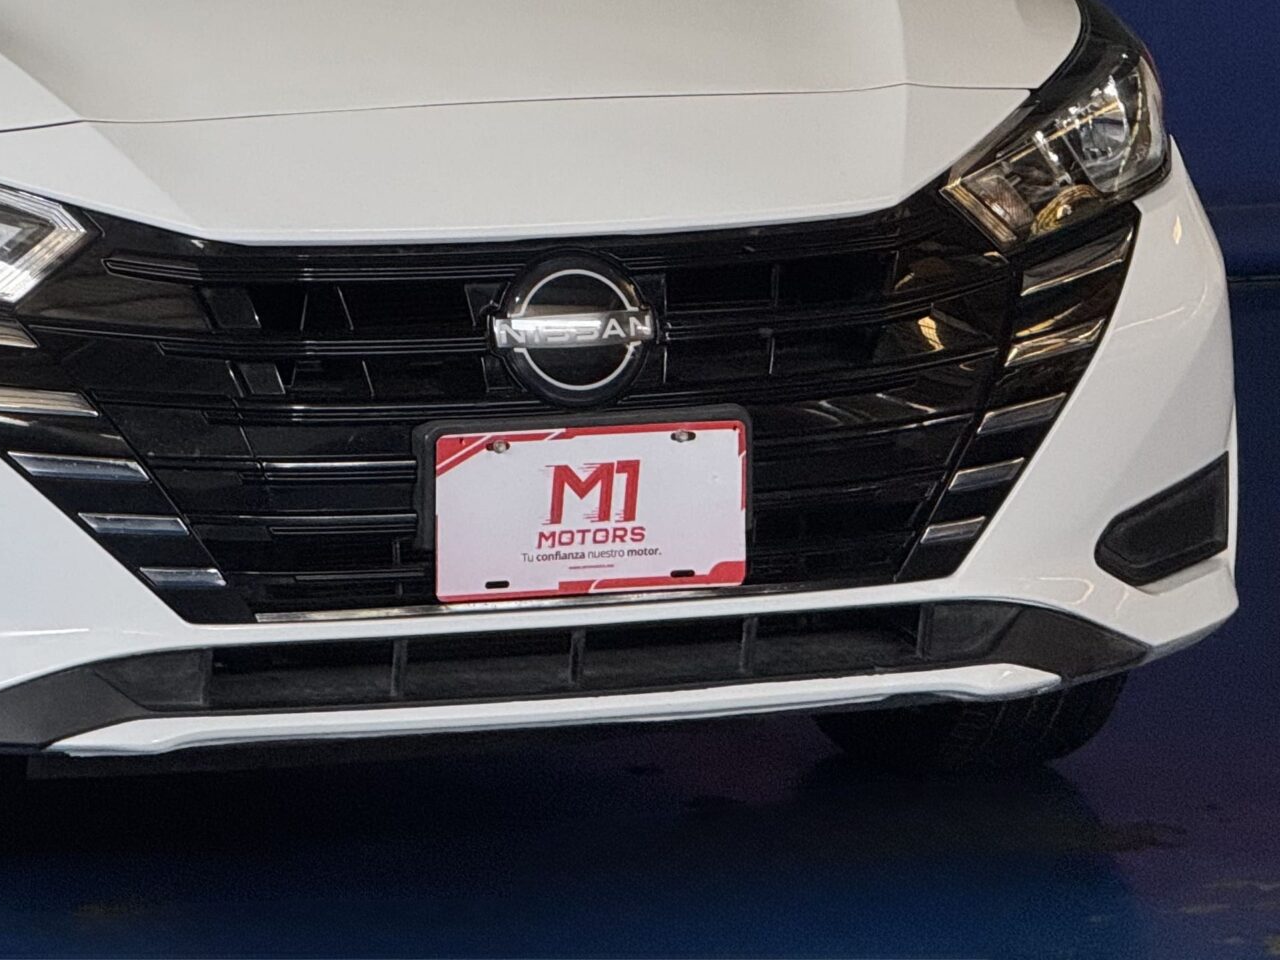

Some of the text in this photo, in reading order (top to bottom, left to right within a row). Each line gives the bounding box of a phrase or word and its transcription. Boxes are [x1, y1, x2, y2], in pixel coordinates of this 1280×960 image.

[497, 315, 652, 344] NISSAN
[542, 459, 641, 526] M1
[536, 526, 647, 549] MOTORS
[521, 547, 663, 563] Tu confianza nuestro motor.
